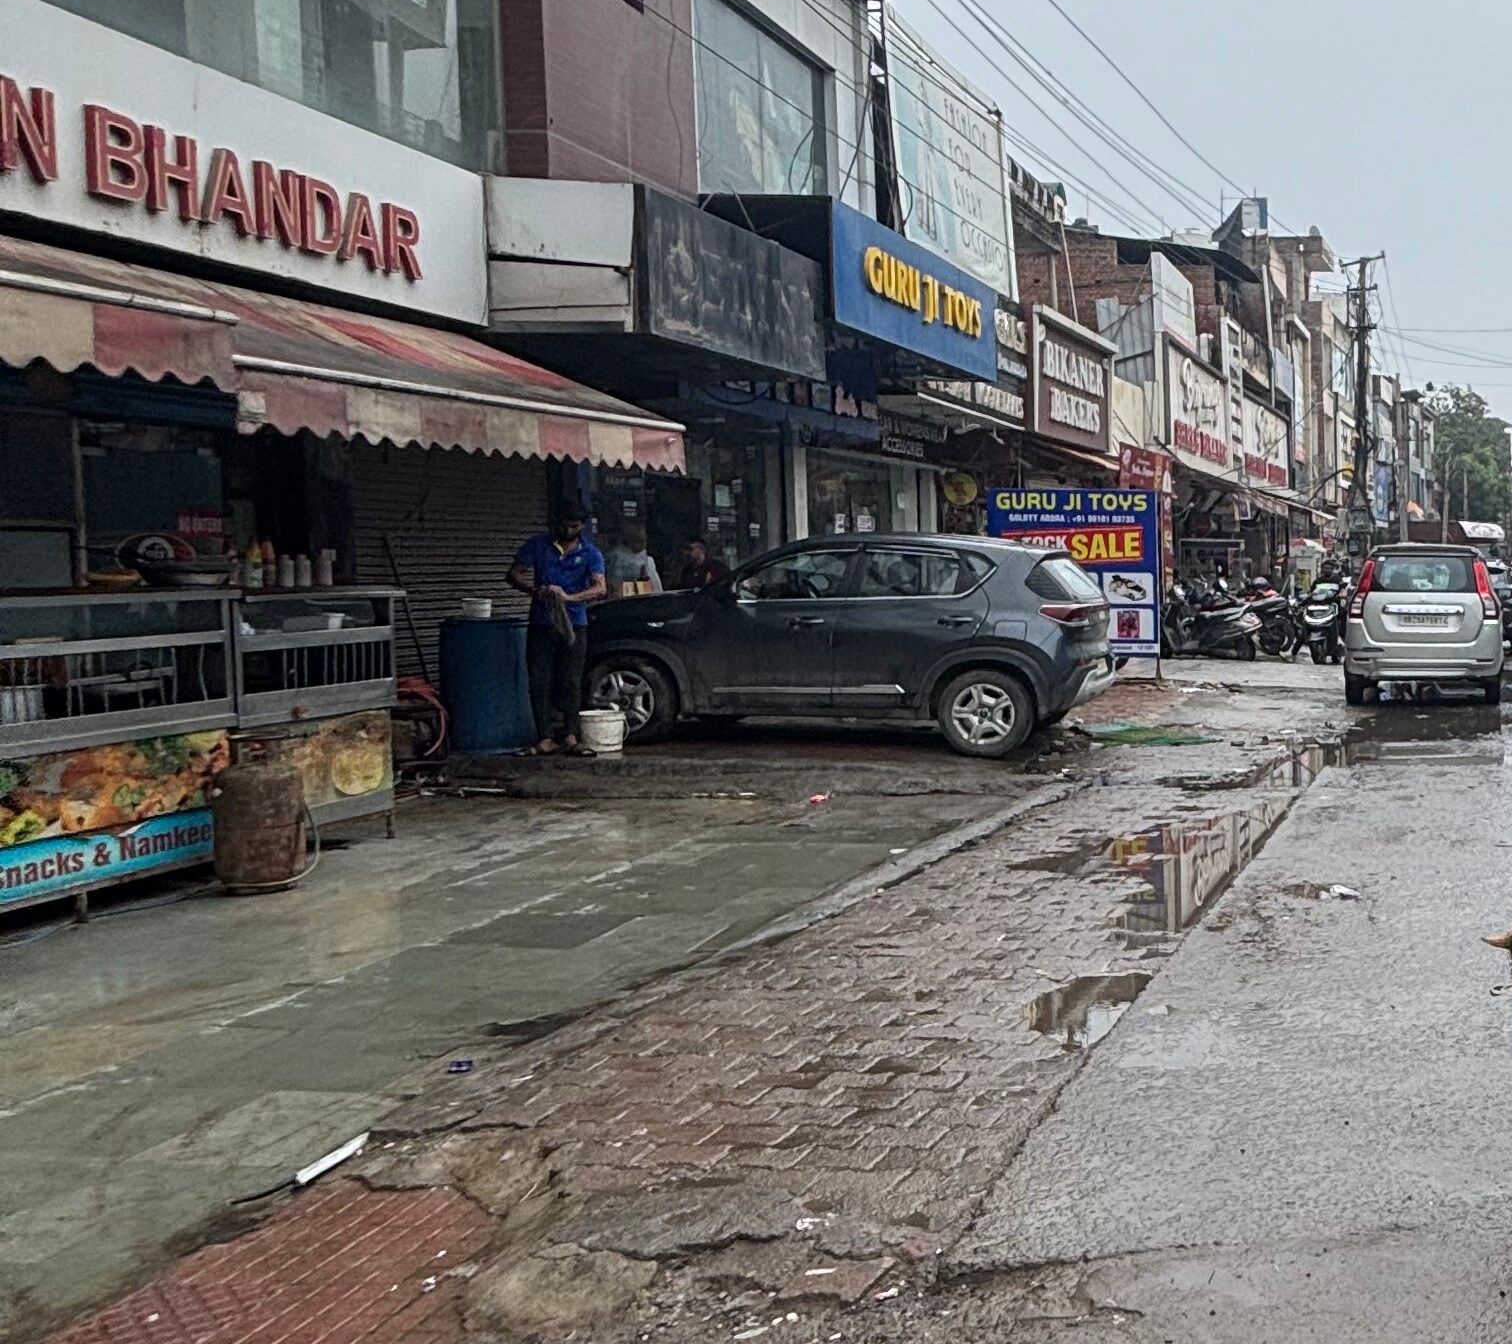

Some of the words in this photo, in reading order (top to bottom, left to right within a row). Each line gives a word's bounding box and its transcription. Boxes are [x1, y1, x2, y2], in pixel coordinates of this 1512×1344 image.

[83, 103, 422, 281] BHANDAR
[864, 246, 921, 312] GURU
[922, 274, 939, 324] JI
[941, 284, 982, 339] TOYS
[1043, 339, 1105, 398] BIKANER
[1050, 386, 1100, 434] BAKERS
[995, 492, 1057, 511] GURU
[1062, 493, 1082, 511] JI
[1088, 493, 1148, 512] TOYS
[1071, 531, 1141, 561] SALE
[93, 841, 112, 867] &
[119, 822, 212, 862] Namkee
